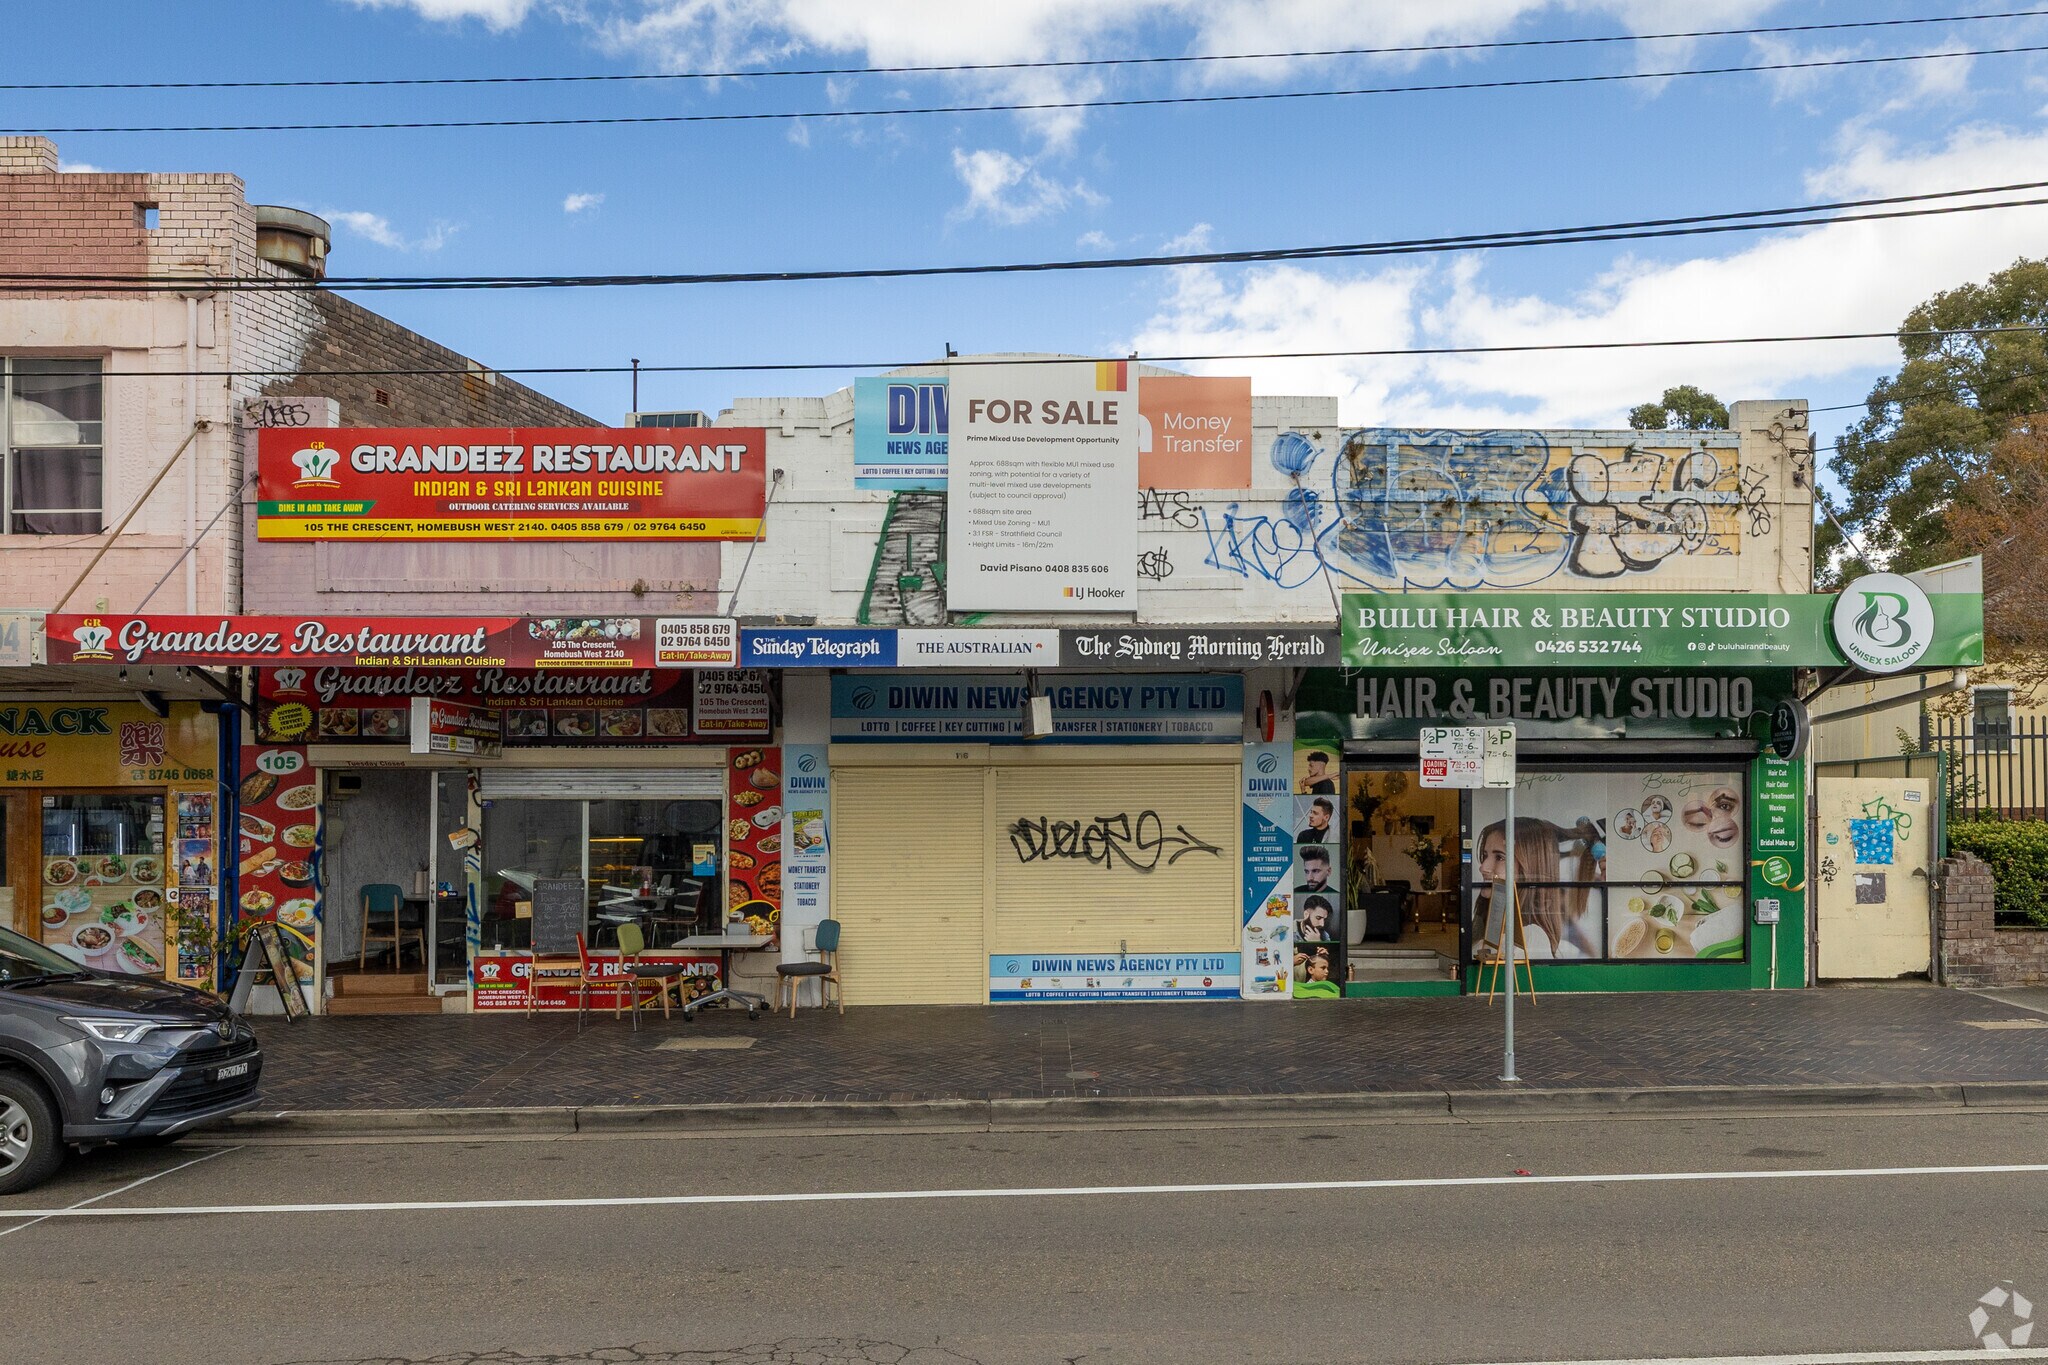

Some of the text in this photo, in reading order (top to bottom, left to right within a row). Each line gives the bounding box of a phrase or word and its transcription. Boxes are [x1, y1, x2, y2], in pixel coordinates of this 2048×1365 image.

[968, 400, 1118, 424] FOR SALE
[1164, 413, 1232, 434] Money
[310, 441, 325, 450] GR
[1027, 436, 1074, 444] Development
[1076, 436, 1120, 444] Opportunity
[1163, 434, 1242, 452] Transfer
[887, 442, 921, 454] NEWS
[350, 445, 747, 473] GRANDEEZ RESTAURANT
[476, 481, 488, 496] &
[495, 481, 521, 496] SRI
[598, 481, 663, 496] CUISINE
[304, 523, 706, 532] 105 THE CRESCENT, HOMEBUSH WEST 2140. 0405 858 679 02 9764 6450
[1076, 588, 1125, 600] LJ Hooker
[84, 618, 101, 627] GR
[1358, 608, 1790, 629] BULU HAIR & BEAUTY STUDIO
[661, 624, 730, 634] 0405 858 679
[118, 619, 486, 663] Grandeez Restaurant
[582, 641, 616, 650] Crescent,
[661, 637, 730, 646] 02 9764 6450
[1076, 634, 1325, 660] The Sydney Morning Herald
[1358, 637, 1642, 657] Unisex Saloon 0426 532 744
[753, 637, 880, 658] Sunday Telegraph
[917, 642, 1032, 653] THE AUSTRALIAN
[1718, 643, 1790, 652] buluhairandbeauty
[1849, 641, 1921, 666] UNISEX SALOON
[355, 656, 505, 666] Indian & Sri Lankan Cuisine
[661, 652, 730, 661] Eat-in/Take-Away
[888, 687, 959, 708] DIWIN
[1044, 687, 1132, 708] AGENCY
[1141, 687, 1182, 708] PTY
[1188, 687, 1225, 708] LTD
[1356, 677, 1753, 719] HAIR & BEAUTY STUDIO
[264, 756, 296, 770] 105
[149, 769, 179, 780] 8746
[791, 777, 825, 788] DIWIN
[1249, 779, 1287, 791] DIWIN
[1642, 773, 1705, 797] Beauty
[1769, 804, 1786, 812] Waxing
[1032, 959, 1225, 971] DIWIN NEWS AGENCY PTY LTD
